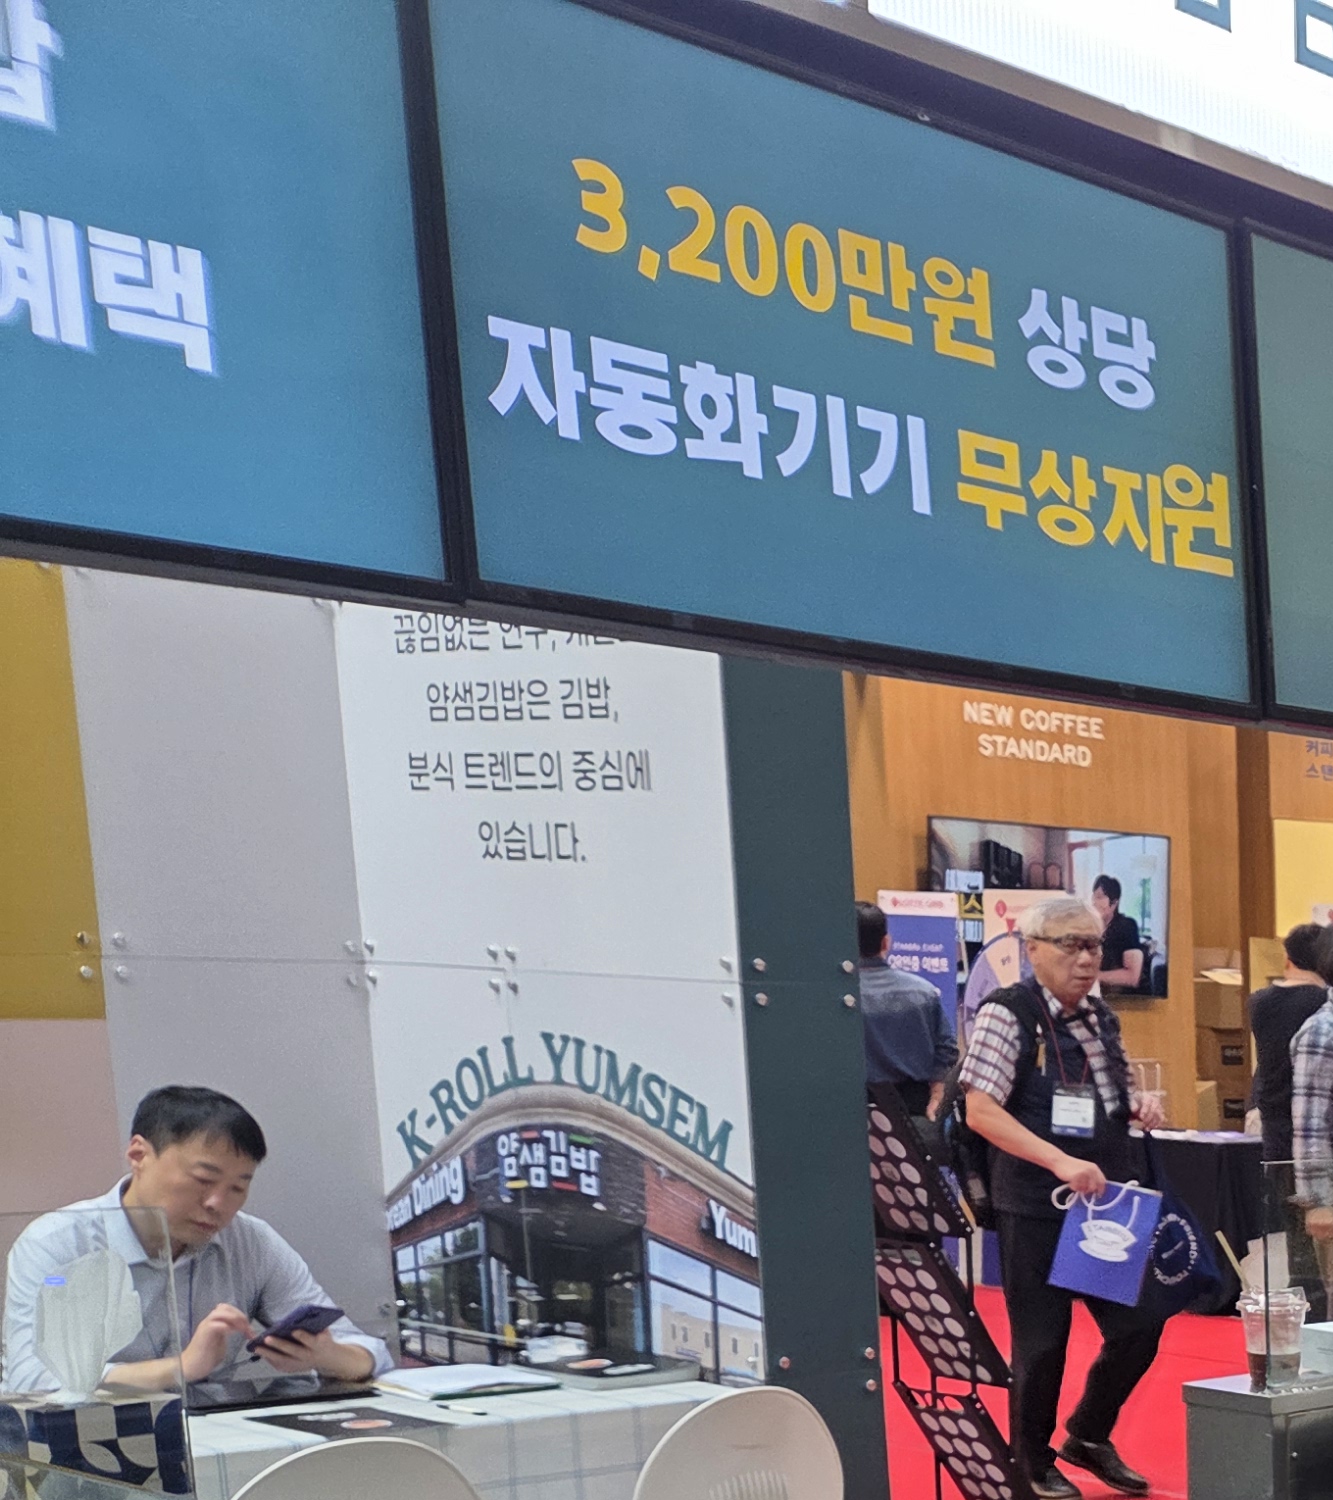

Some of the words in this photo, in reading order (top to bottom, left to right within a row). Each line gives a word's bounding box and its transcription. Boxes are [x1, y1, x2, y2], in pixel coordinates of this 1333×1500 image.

[572, 158, 996, 369] 3,200만원
[1018, 287, 1158, 411] 상당
[487, 315, 933, 517] 자동화기기
[957, 430, 1235, 578] 무상지원
[426, 678, 550, 722] 얌샘김밥은
[560, 676, 619, 723] 김밥,
[963, 700, 1014, 728] NEW
[1019, 707, 1105, 740] COFFEE
[408, 751, 455, 791] 분식
[464, 751, 563, 791] 트렌드의
[572, 748, 652, 791] 중심에
[978, 733, 1092, 768] STANDARD
[1305, 740, 1333, 757] 커피
[478, 820, 586, 863] 있습니다.
[396, 1036, 533, 1169] K-ROLL
[541, 1032, 733, 1170] YUMSEM
[412, 1155, 466, 1216] Dining
